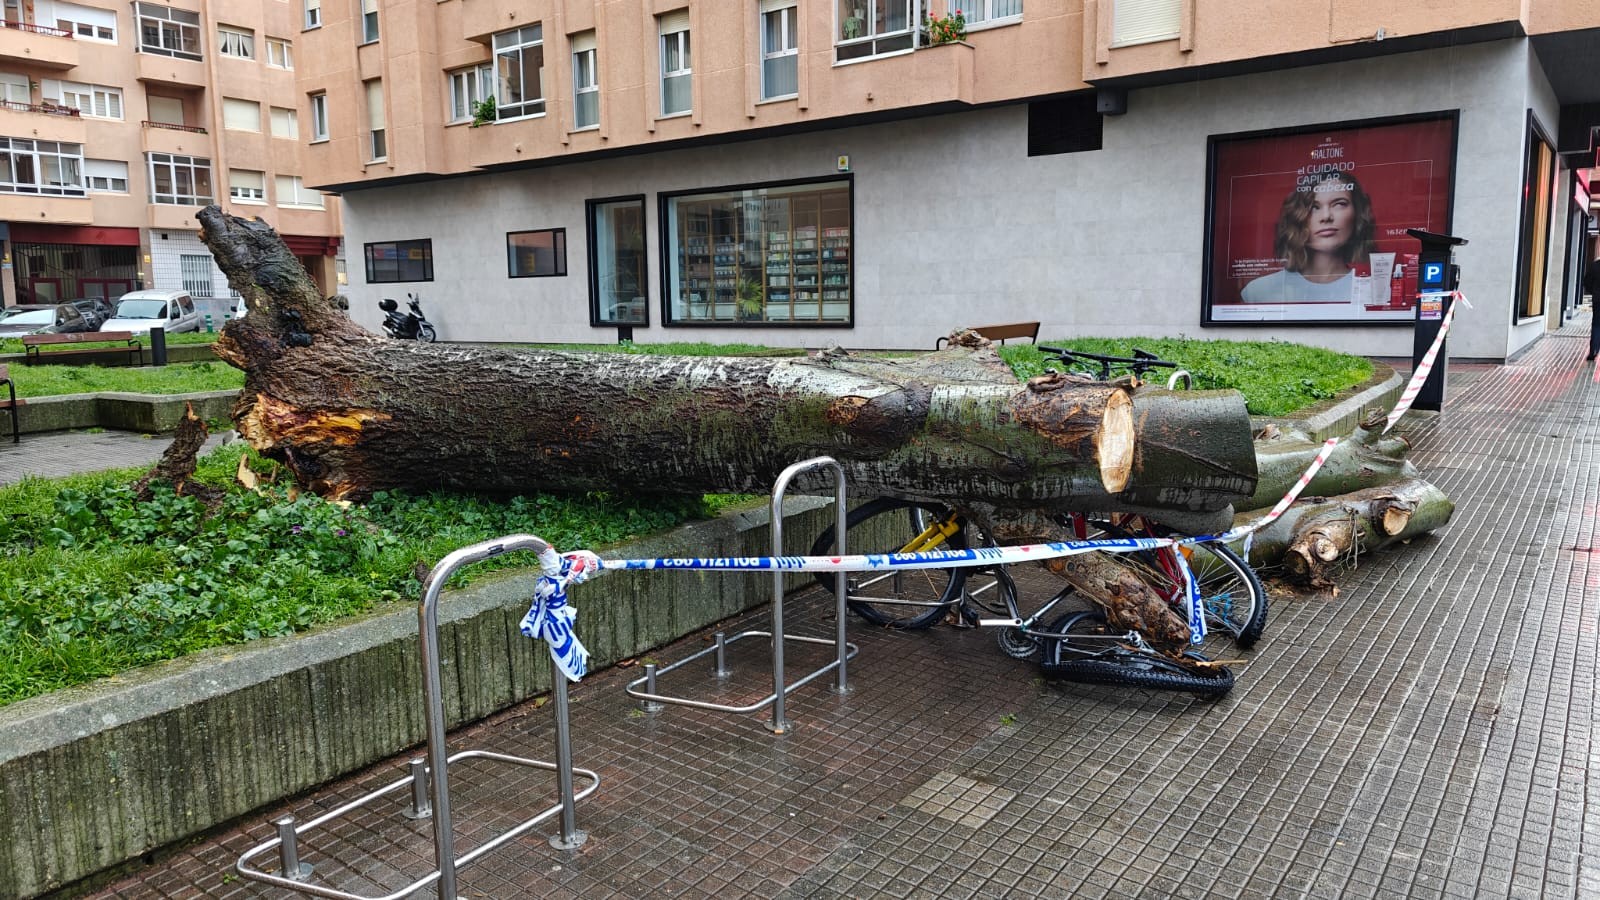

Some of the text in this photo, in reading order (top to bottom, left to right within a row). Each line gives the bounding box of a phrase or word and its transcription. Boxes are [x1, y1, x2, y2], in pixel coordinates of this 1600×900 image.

[1297, 161, 1355, 175] el CUIDADO
[1296, 173, 1340, 185] CAPILAR
[1296, 182, 1354, 193] con cabeza
[1427, 266, 1440, 281] P
